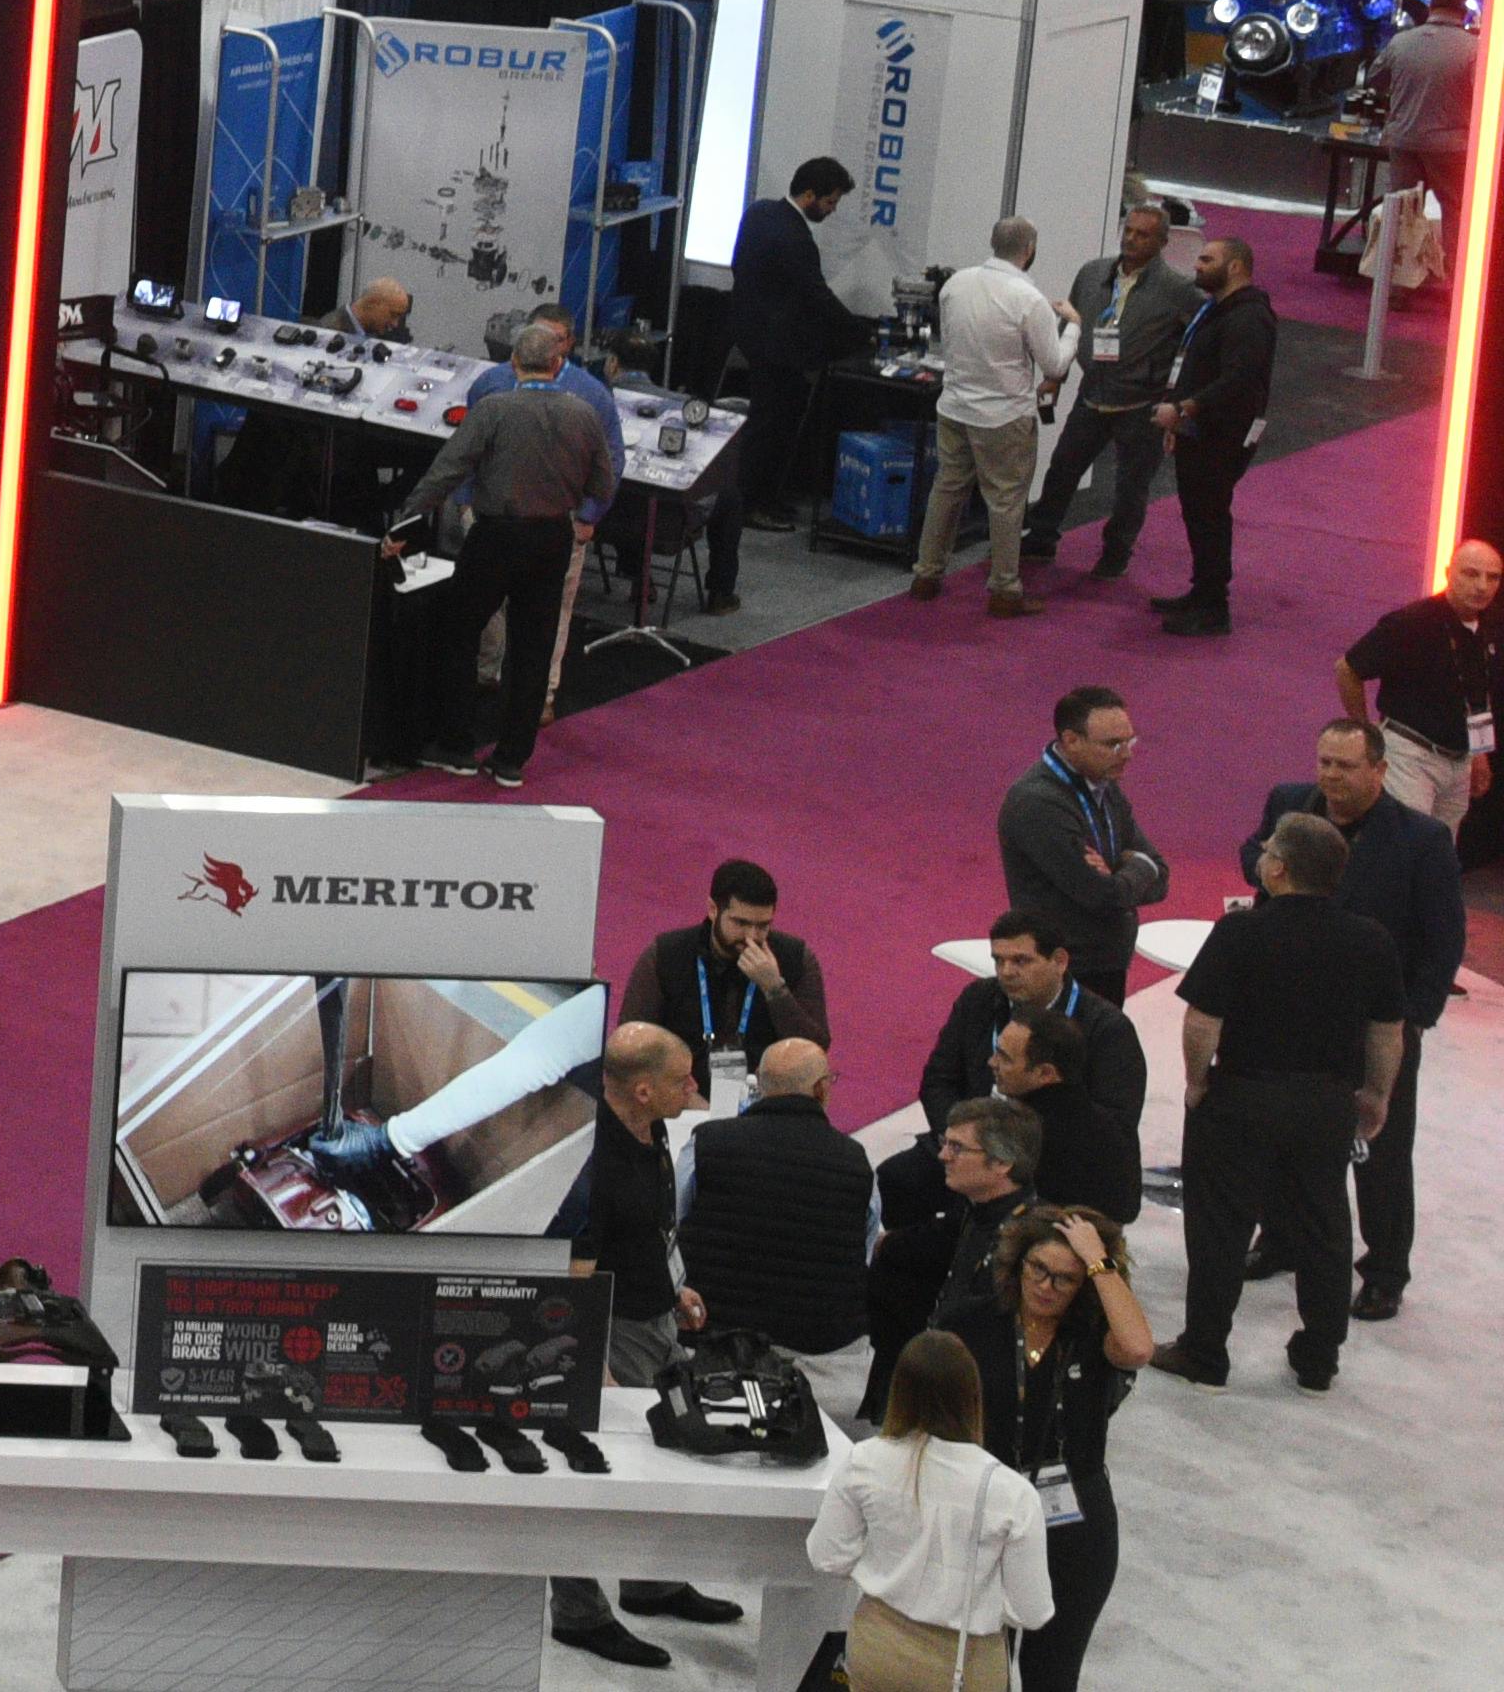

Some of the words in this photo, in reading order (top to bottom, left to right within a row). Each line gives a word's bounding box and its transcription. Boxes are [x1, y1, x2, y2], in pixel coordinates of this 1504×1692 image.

[414, 40, 569, 72] ROBUR
[870, 65, 912, 227] ROBUR
[272, 874, 535, 911] MERITOR
[480, 1286, 538, 1300] WARRANTY?
[173, 1321, 184, 1333] 10
[185, 1321, 224, 1334] MILLION
[226, 1323, 281, 1340] WORLD
[328, 1322, 358, 1334] SEALED
[173, 1333, 191, 1345] AIR
[195, 1333, 222, 1346] DISC
[327, 1332, 364, 1344] HOUSING
[172, 1345, 221, 1361] BRAKES
[226, 1341, 279, 1362] WIDE
[326, 1342, 357, 1353] DESIGN
